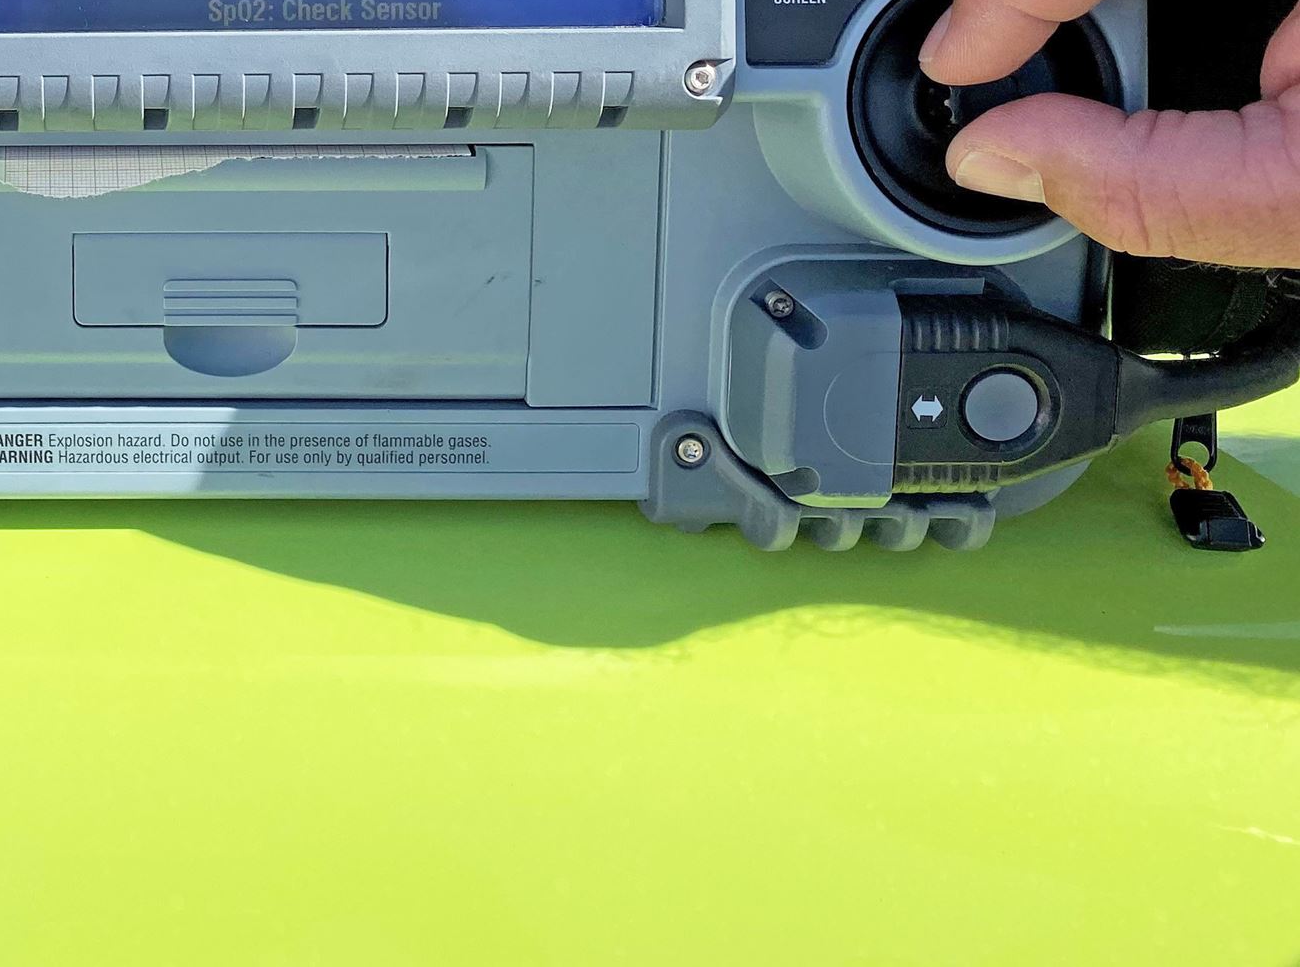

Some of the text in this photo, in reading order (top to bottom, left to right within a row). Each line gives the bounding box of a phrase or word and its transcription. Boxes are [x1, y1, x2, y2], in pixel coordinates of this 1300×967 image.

[48, 433, 113, 451] Explosion
[117, 433, 165, 448] hazard.
[171, 433, 189, 447] Do
[194, 434, 216, 447] not
[220, 437, 243, 448] use
[248, 433, 260, 447] in
[264, 433, 285, 447] the
[289, 436, 350, 451] presence
[355, 433, 369, 447] of
[372, 433, 444, 448] flammable
[448, 436, 492, 451] gases.
[58, 450, 129, 464] Hazardous
[133, 450, 193, 464] electrical
[197, 451, 244, 467] output.
[249, 450, 271, 464] For
[275, 453, 299, 464] use
[303, 450, 332, 467] only
[336, 450, 352, 467] by
[356, 450, 414, 467] qualified
[418, 450, 490, 467] personnel.
